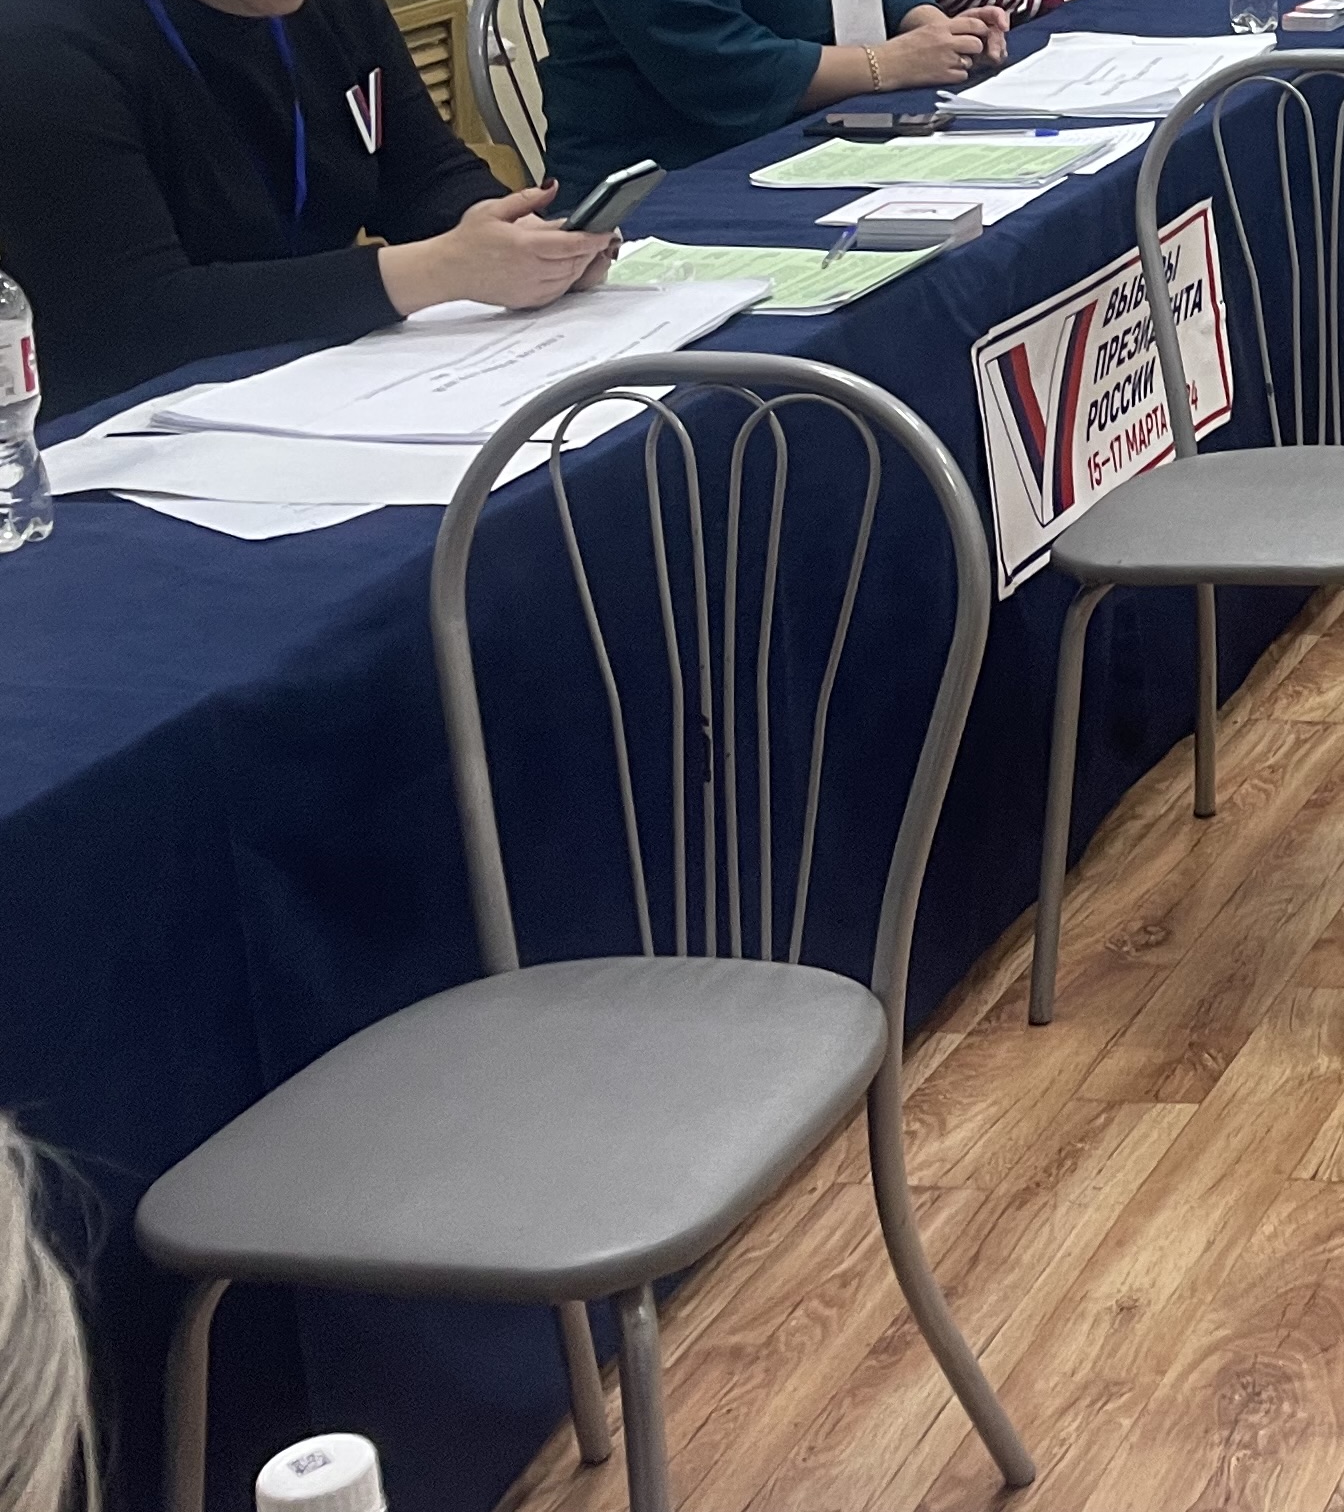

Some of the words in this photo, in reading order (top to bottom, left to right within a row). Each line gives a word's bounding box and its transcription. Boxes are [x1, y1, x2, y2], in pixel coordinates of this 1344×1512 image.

[1102, 244, 1181, 328] ВЫБЫ
[1093, 278, 1203, 385] ПРЕЗИНТА
[1086, 356, 1156, 442] РОССИИ
[1125, 403, 1168, 463] МАРТА
